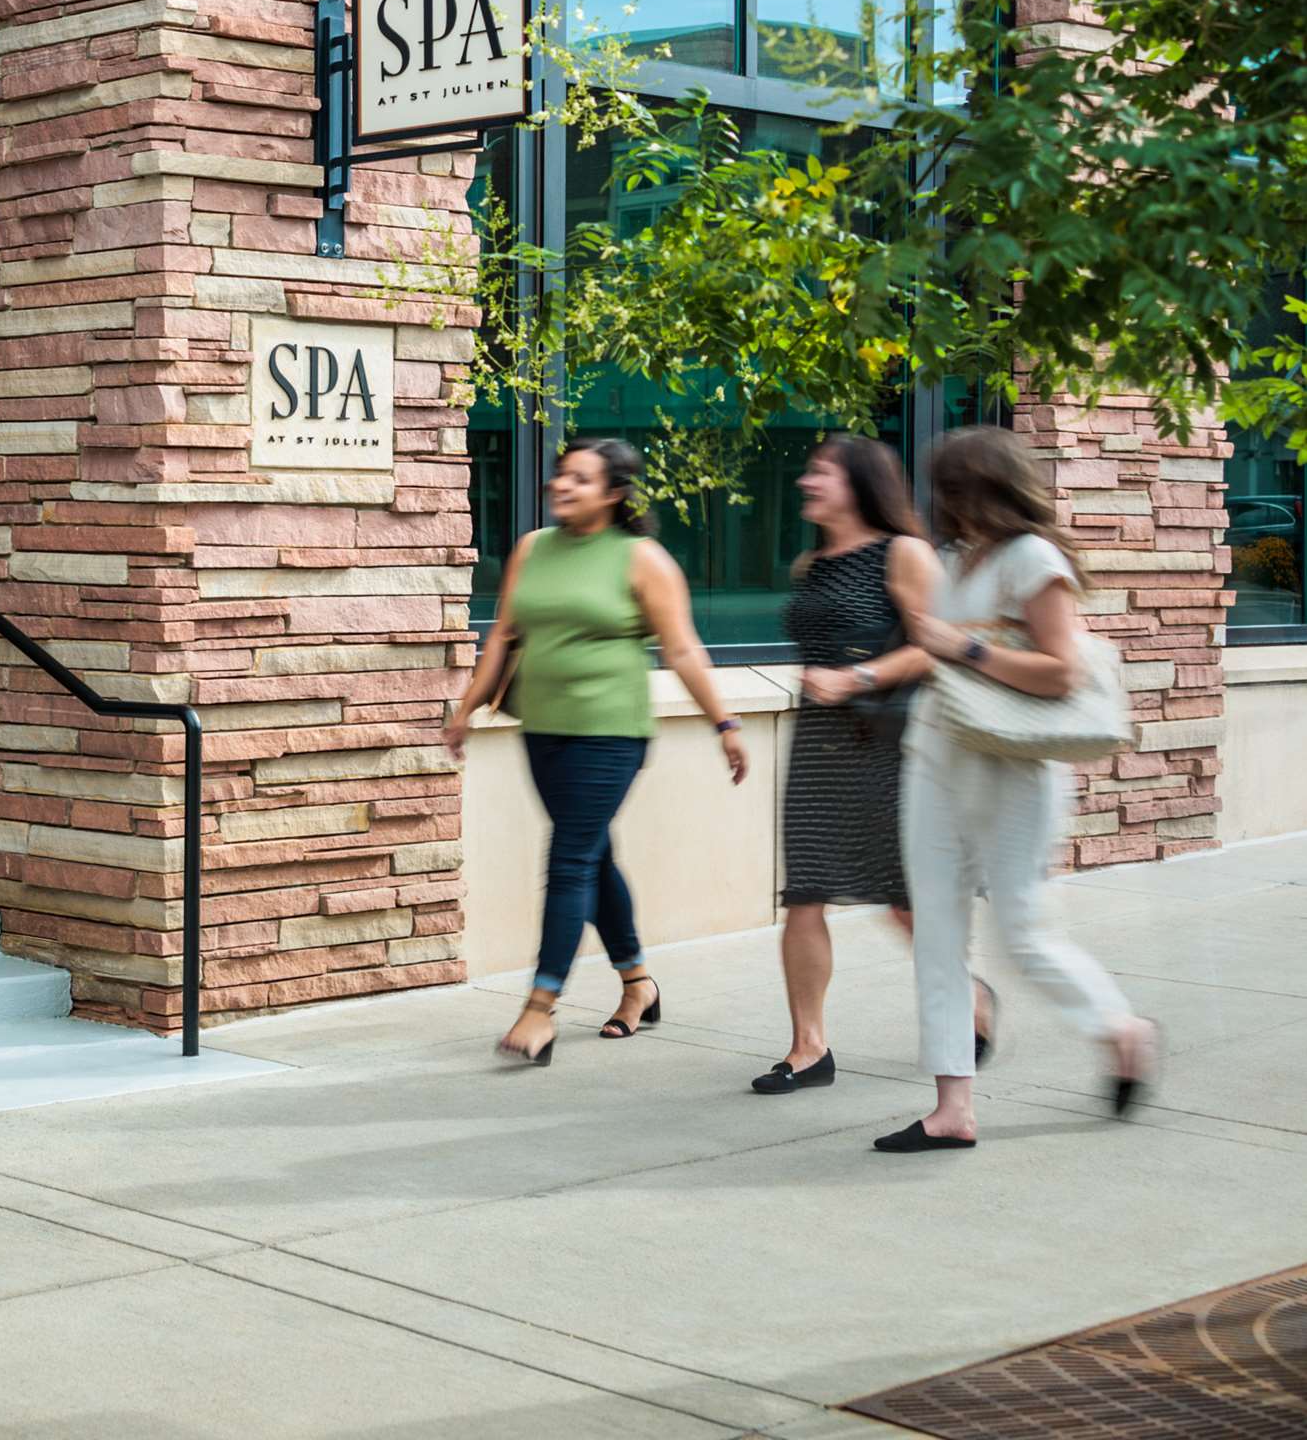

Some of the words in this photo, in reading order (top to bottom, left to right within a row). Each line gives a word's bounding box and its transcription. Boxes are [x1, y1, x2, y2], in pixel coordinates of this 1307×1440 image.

[378, 96, 398, 106] AT
[410, 91, 430, 101] ST
[443, 79, 509, 98] JULIEN
[268, 343, 379, 422] SPA
[268, 435, 285, 443] AT
[296, 436, 314, 444] ST
[325, 437, 379, 446] JULIEN
